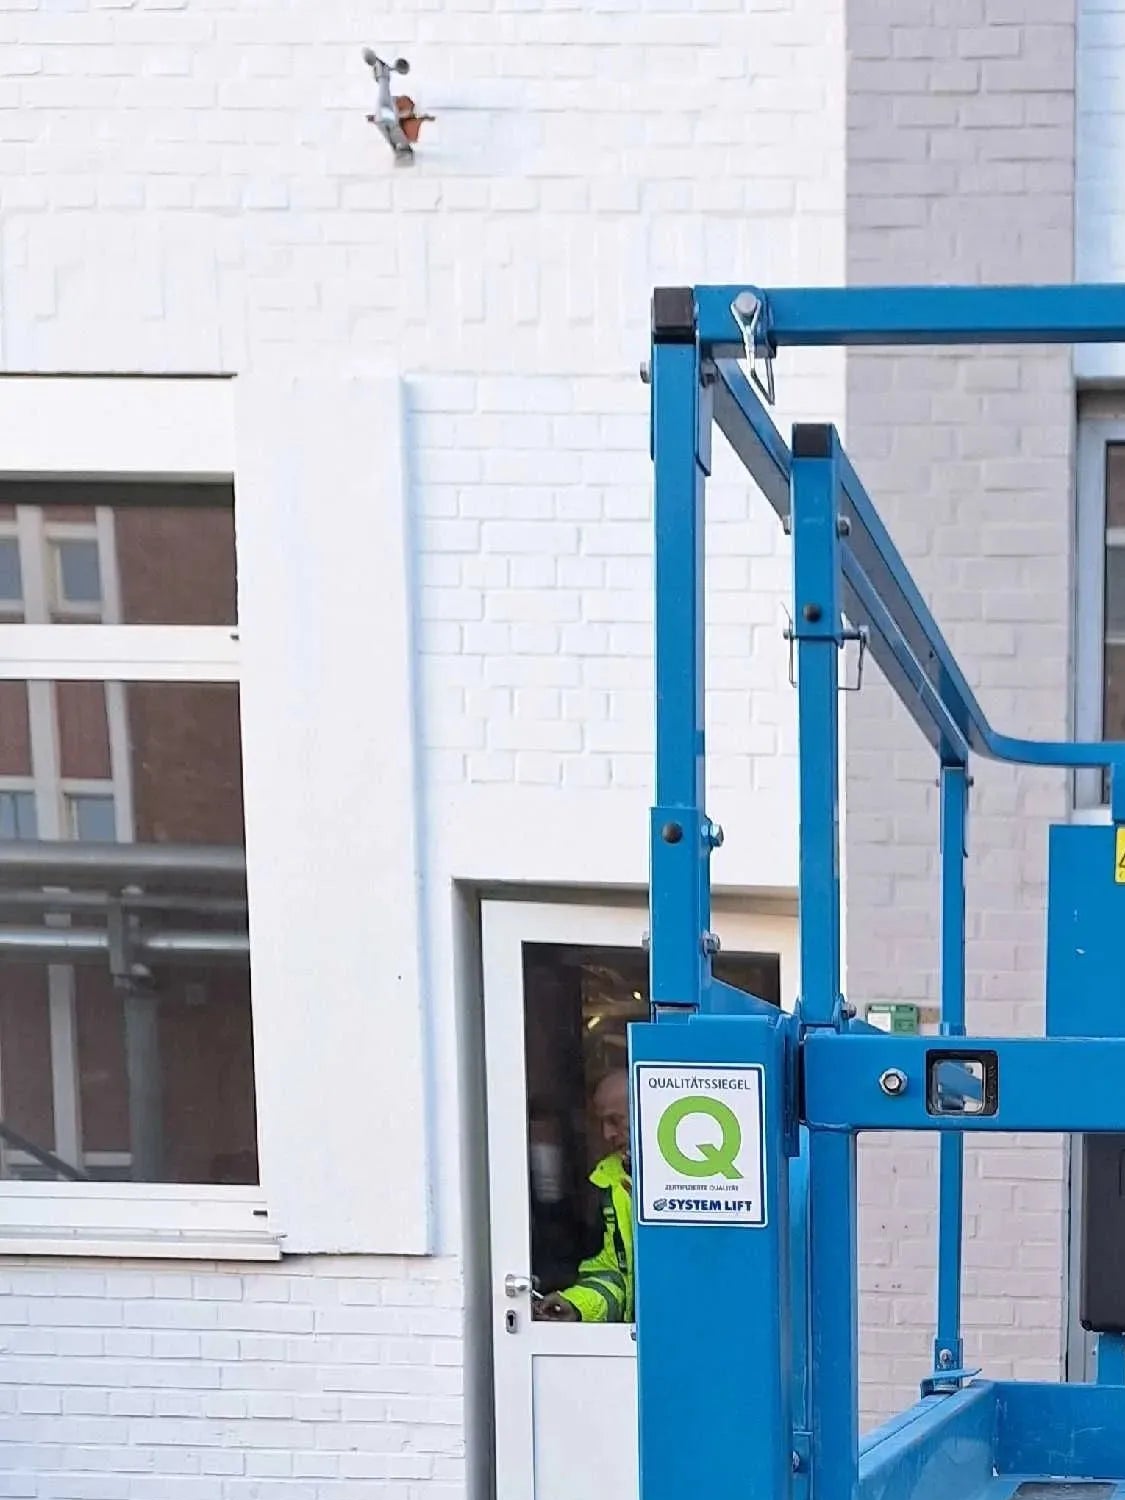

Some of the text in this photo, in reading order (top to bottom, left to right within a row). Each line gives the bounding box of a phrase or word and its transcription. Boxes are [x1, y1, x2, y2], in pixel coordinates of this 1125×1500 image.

[648, 1076, 751, 1090] QUALITÄTSSIEGEL
[657, 1096, 744, 1180] Q
[668, 1199, 752, 1212] SYSTEM LIFT
